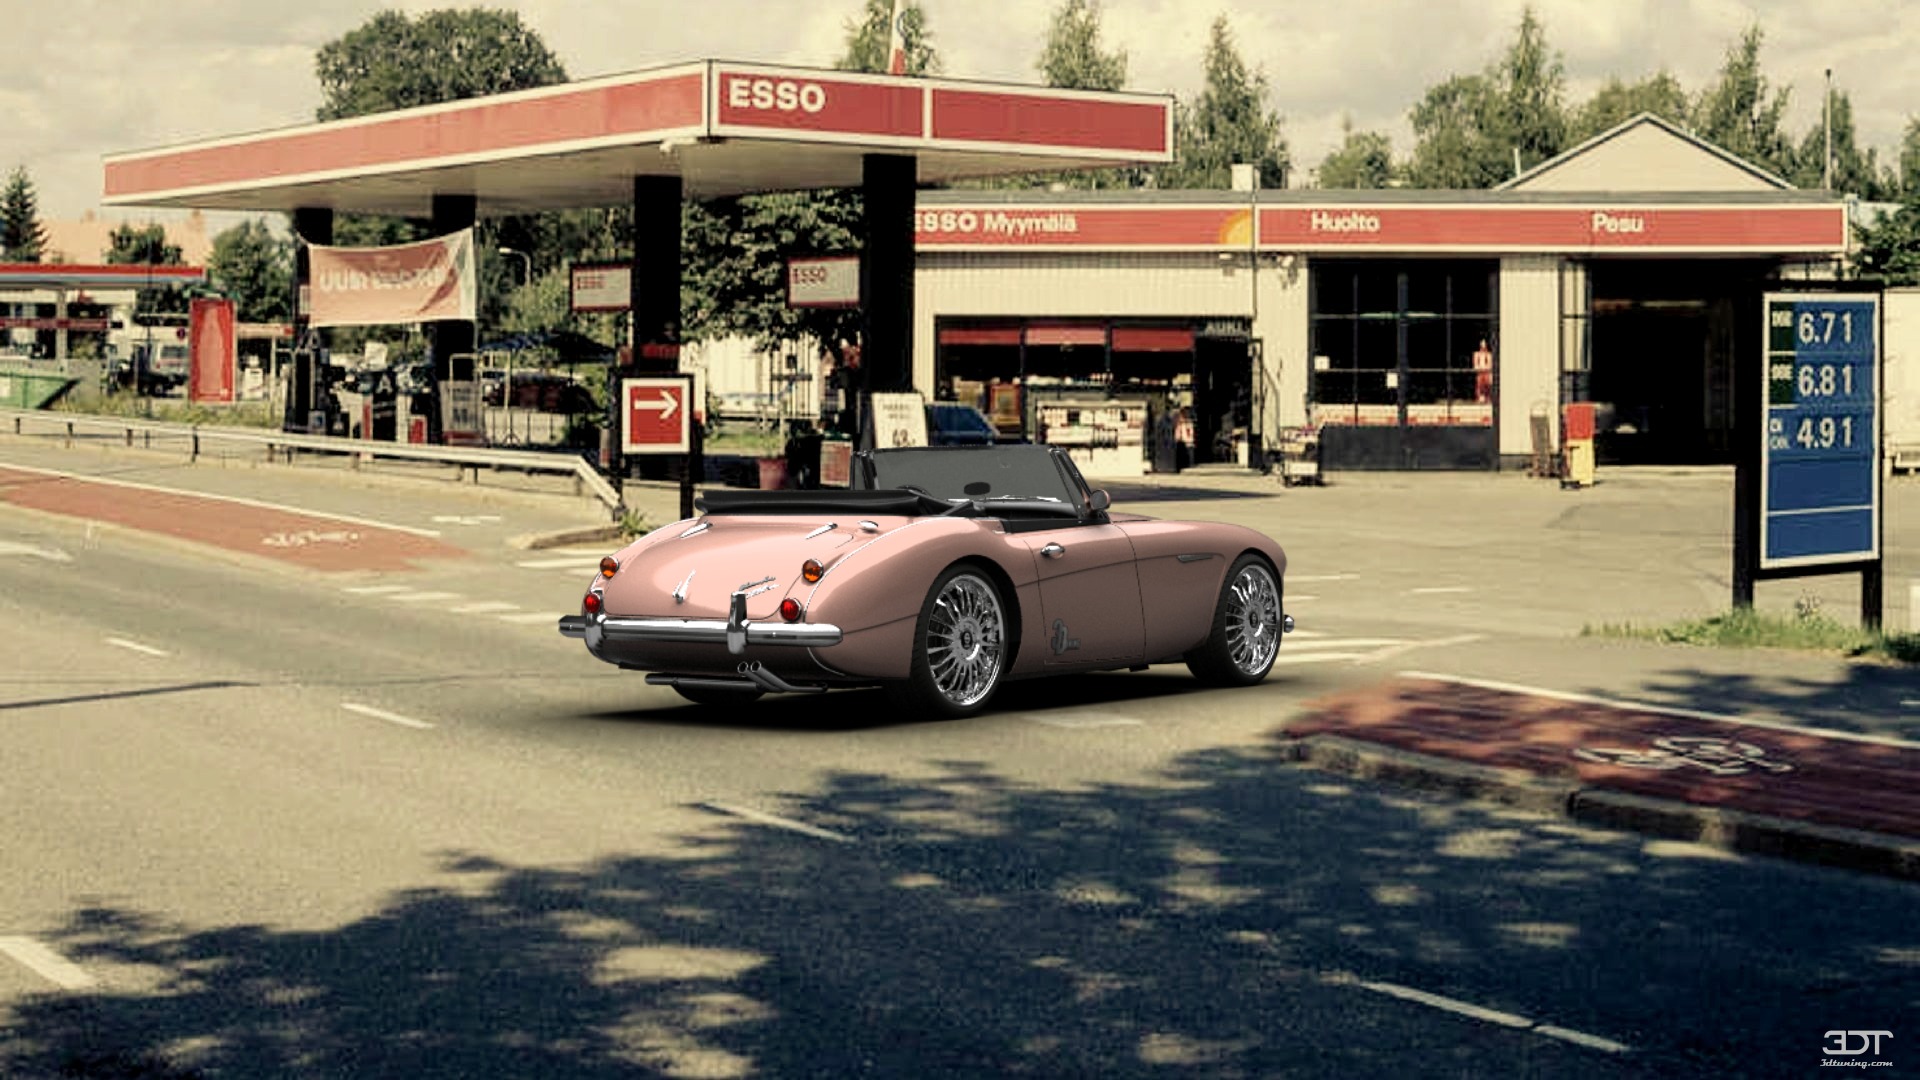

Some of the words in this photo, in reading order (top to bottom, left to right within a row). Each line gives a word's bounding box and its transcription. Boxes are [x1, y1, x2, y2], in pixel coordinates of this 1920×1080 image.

[729, 79, 826, 113] ESSO
[1311, 210, 1381, 233] Huolto
[1591, 212, 1645, 234] Pesu
[1799, 312, 1852, 344] 6.71
[1799, 364, 1852, 397] 6.81
[1797, 416, 1852, 448] 4.91
